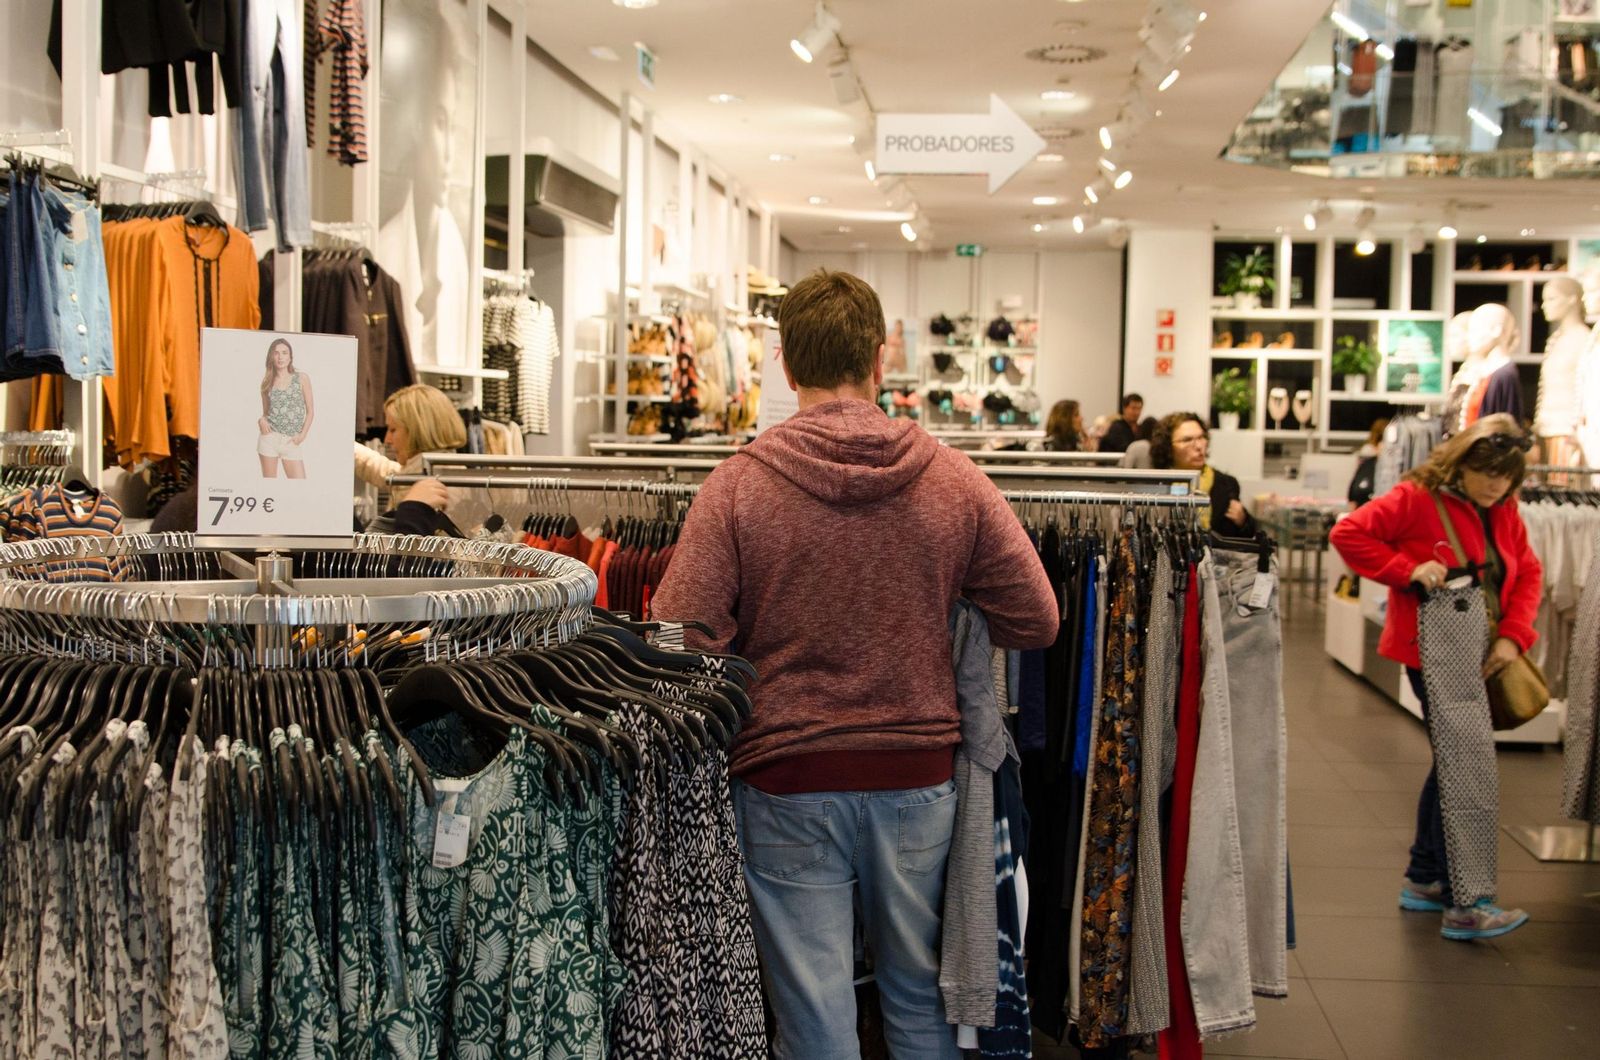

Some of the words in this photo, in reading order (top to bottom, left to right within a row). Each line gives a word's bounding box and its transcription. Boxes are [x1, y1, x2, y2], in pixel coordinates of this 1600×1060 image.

[885, 135, 1015, 152] PROBADORES
[208, 496, 257, 526] 7,99
[262, 498, 275, 513] €
